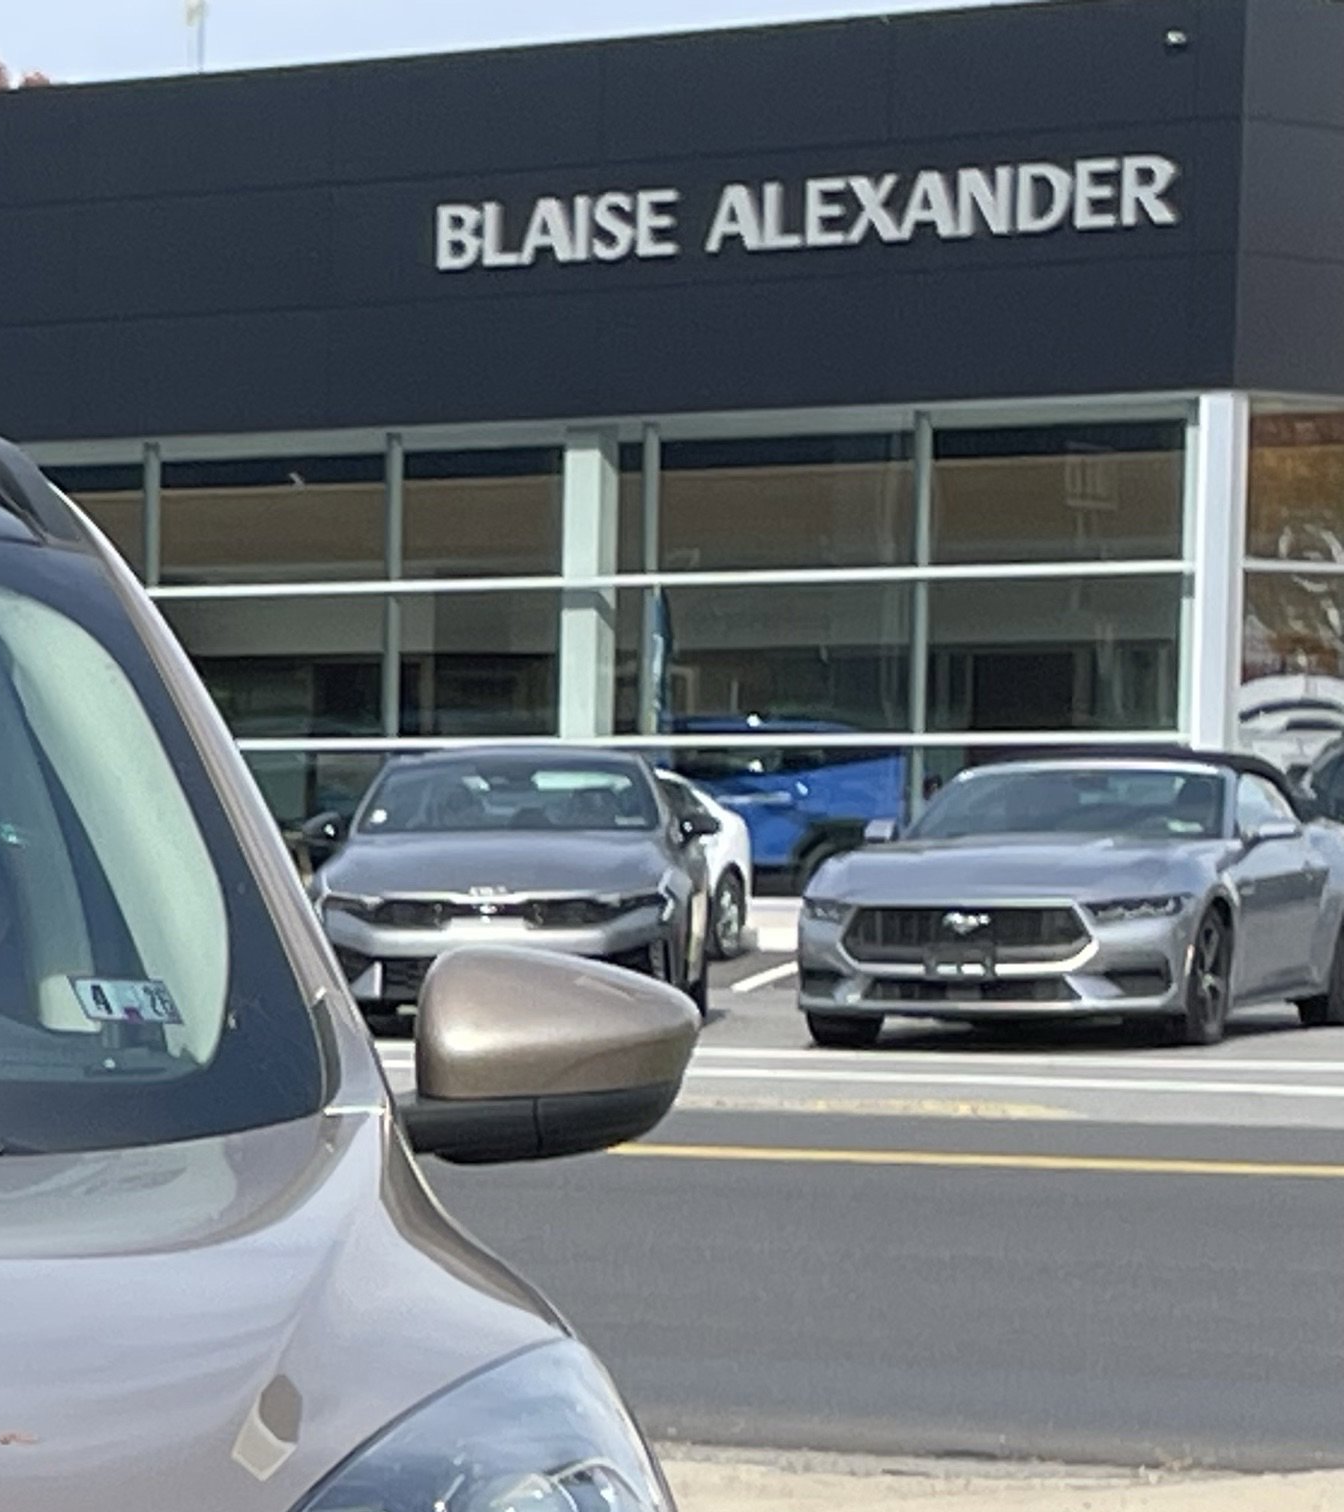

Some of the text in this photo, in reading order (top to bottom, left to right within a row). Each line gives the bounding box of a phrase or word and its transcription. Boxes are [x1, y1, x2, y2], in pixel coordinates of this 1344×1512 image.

[436, 153, 1177, 271] BLAISE ALEXANDER
[90, 984, 114, 1015] 4
